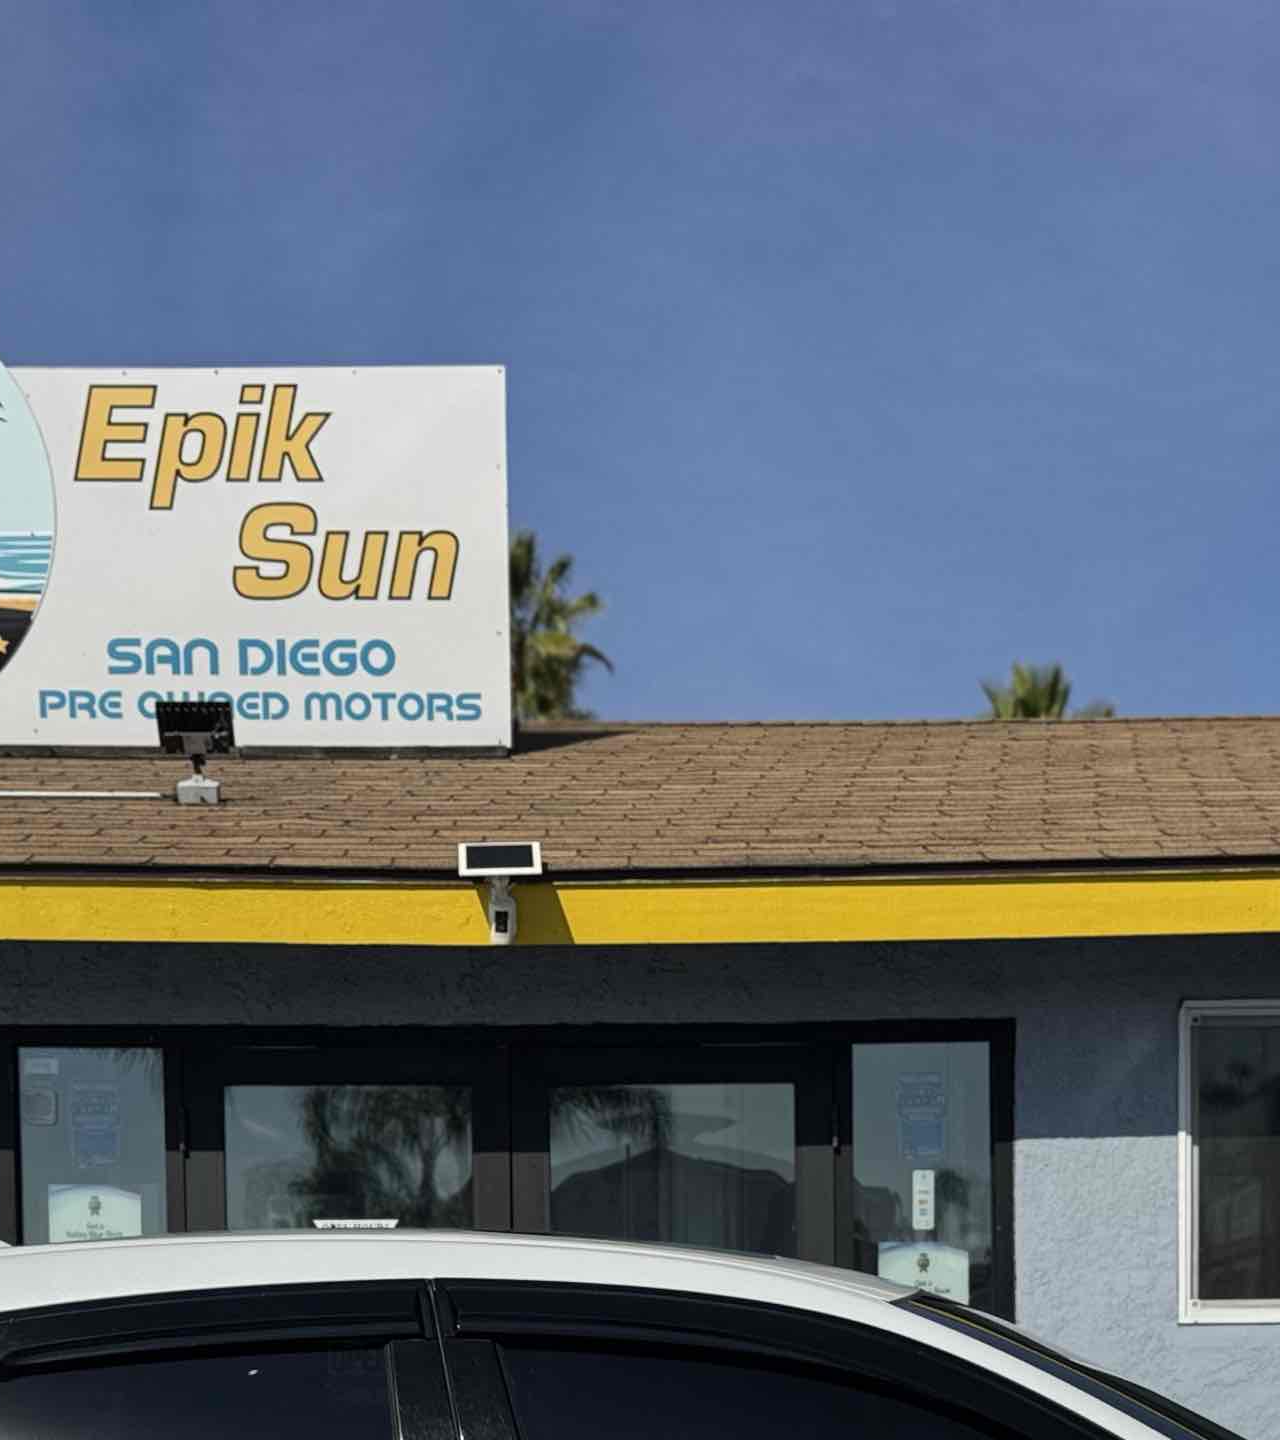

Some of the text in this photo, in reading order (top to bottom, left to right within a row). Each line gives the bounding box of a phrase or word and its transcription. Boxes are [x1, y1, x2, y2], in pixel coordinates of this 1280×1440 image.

[74, 384, 332, 510] Epik
[233, 502, 459, 600] Sun
[106, 638, 396, 677] SAN DIEGO
[38, 690, 123, 719] PRE
[304, 692, 482, 721] MOTORS
